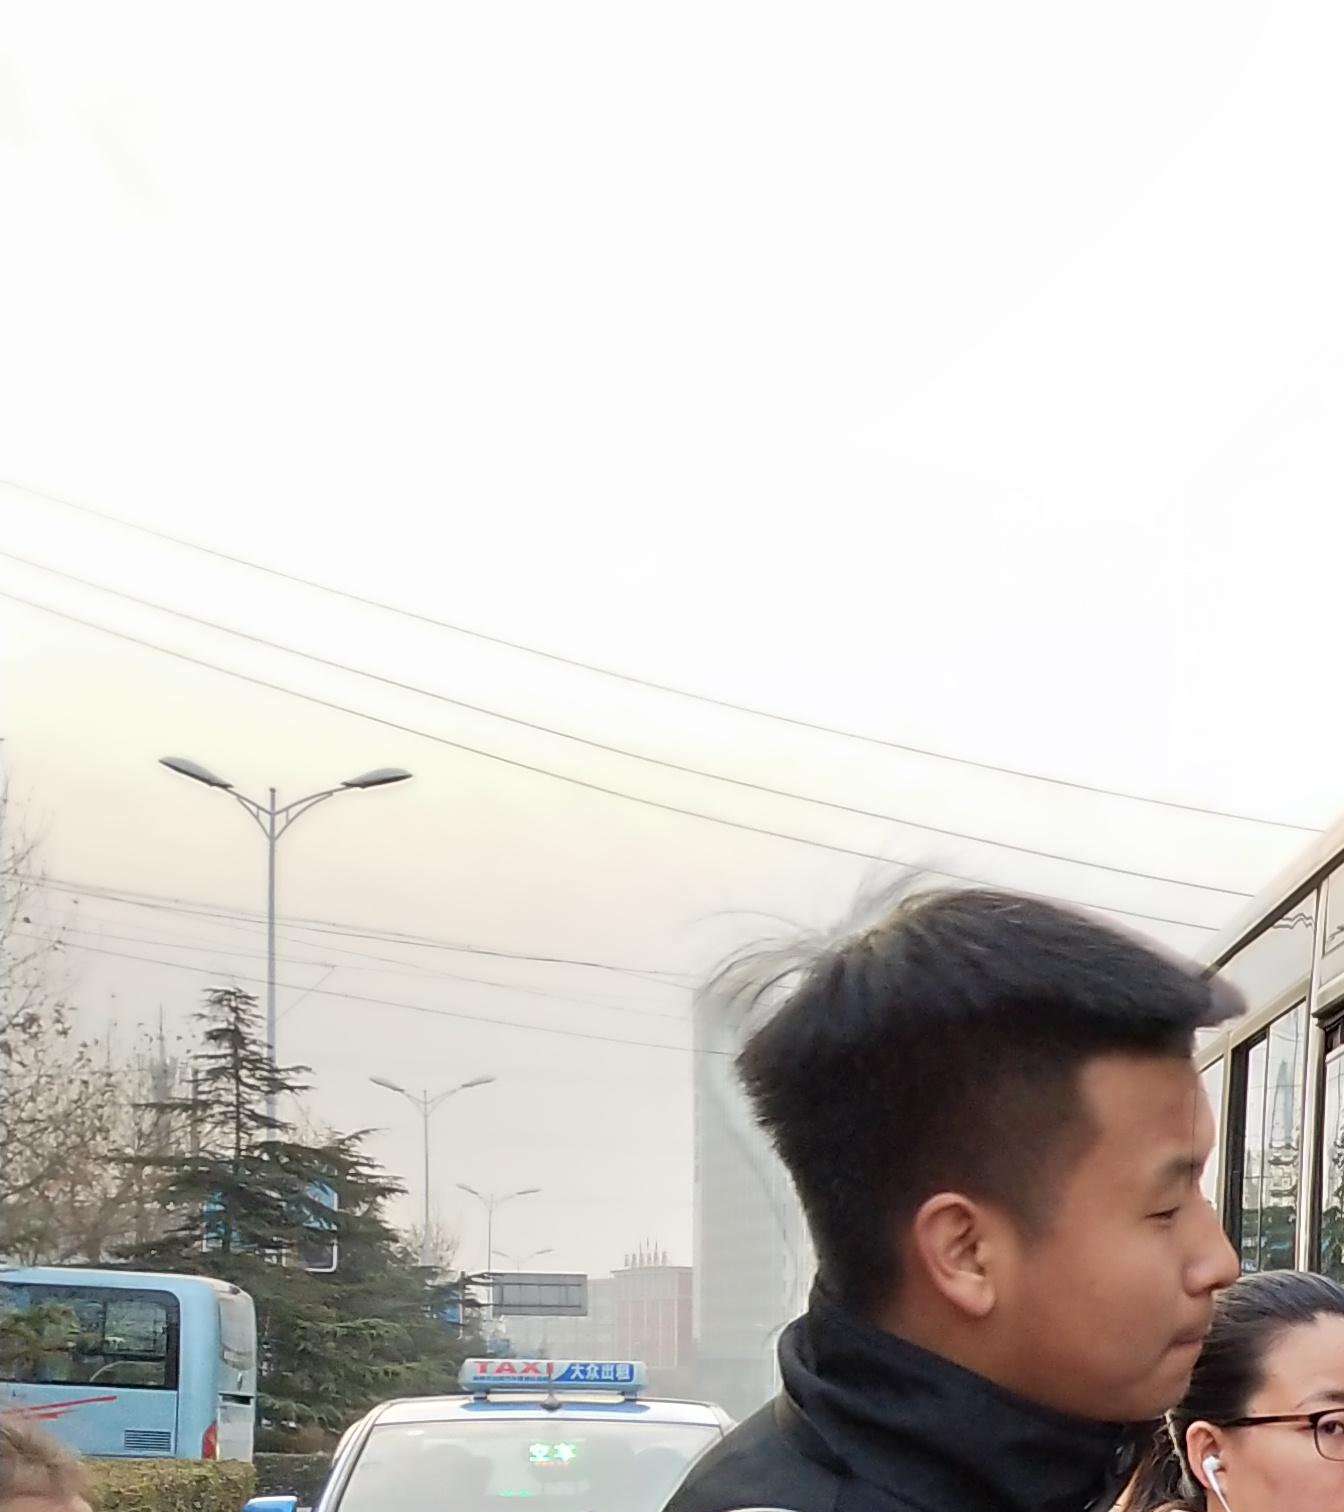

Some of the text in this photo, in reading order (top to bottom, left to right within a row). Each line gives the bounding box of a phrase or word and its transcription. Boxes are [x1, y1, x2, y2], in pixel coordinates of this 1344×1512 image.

[473, 1361, 555, 1375] TAXI
[570, 1364, 631, 1381] 大众出租
